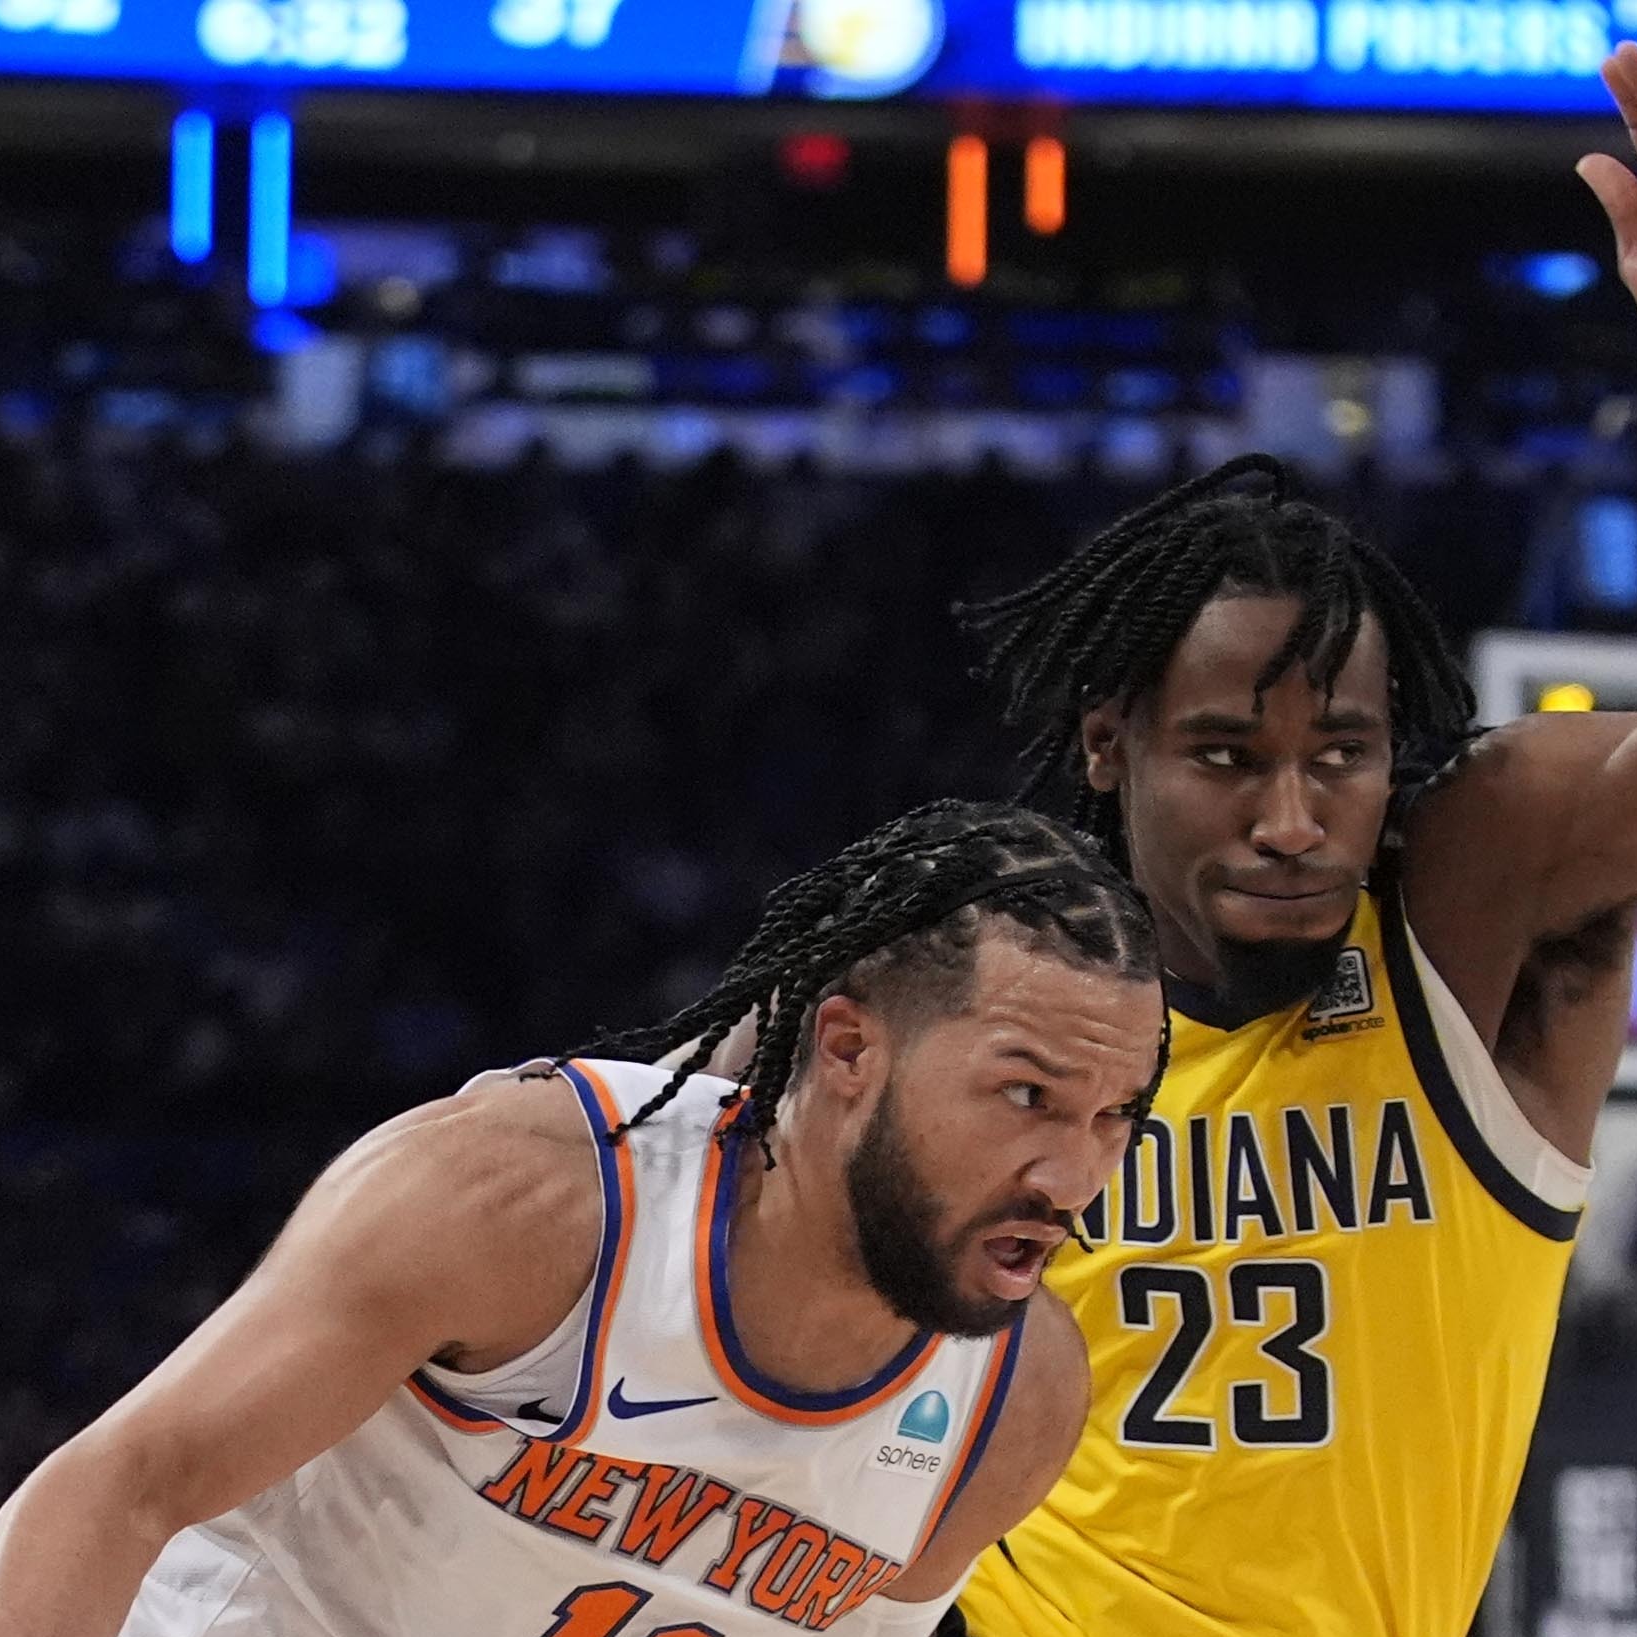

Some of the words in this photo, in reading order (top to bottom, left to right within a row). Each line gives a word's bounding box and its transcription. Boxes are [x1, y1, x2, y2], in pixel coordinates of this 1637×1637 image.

[1079, 1098, 1436, 1249] DIANA
[1117, 1256, 1337, 1452] 23
[475, 1435, 743, 1570] NEW
[876, 1445, 941, 1473] sphere
